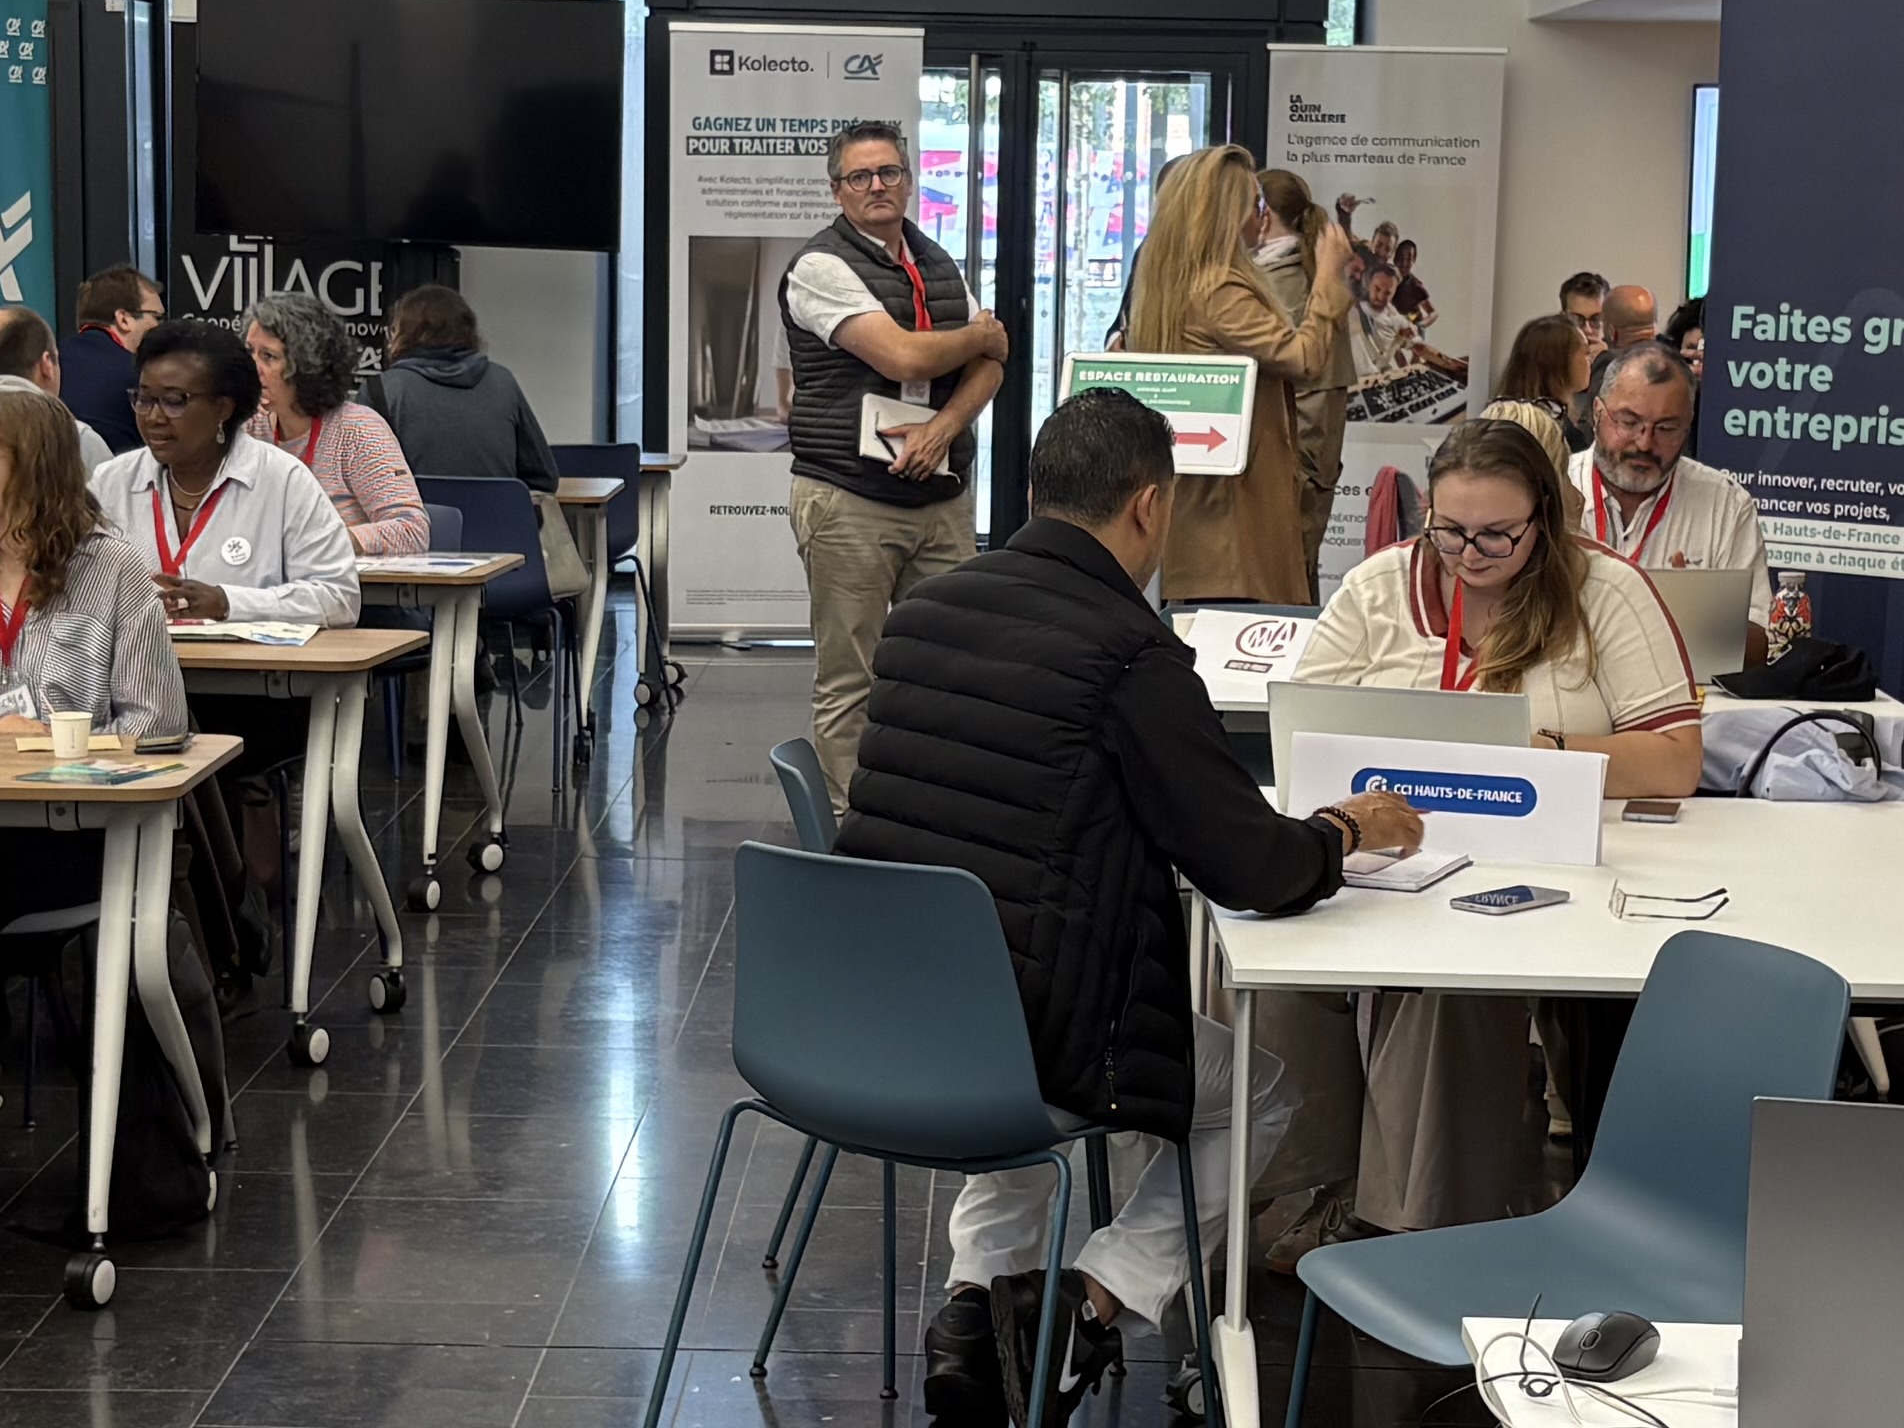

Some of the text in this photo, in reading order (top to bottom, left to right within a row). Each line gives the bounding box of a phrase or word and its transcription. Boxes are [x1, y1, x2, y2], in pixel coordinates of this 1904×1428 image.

[738, 55, 814, 72] Kolecto.
[1289, 94, 1303, 104] LA
[1289, 104, 1322, 113] QUIN
[692, 116, 752, 132] GAGNEZ
[756, 118, 777, 132] UN
[779, 118, 828, 133] TEMPS
[1289, 113, 1347, 123] CAILLERIE
[688, 138, 828, 154] POUR TRAITER VOS
[1287, 133, 1480, 148] L'agence de communication
[1286, 150, 1466, 166] la plus marteau de France
[701, 187, 763, 196] administratives
[741, 199, 780, 208] conforme
[1731, 303, 1852, 345] Faites
[1079, 370, 1240, 385] ESPACE RESTAURATION
[1728, 356, 1834, 393] votre
[1758, 470, 1817, 491] innover,
[1820, 475, 1884, 497] recruter,
[1805, 501, 1830, 515] vos
[1834, 502, 1890, 522] projets,
[1773, 521, 1900, 546] Hauts-de-France
[1815, 548, 1825, 564] à
[1829, 551, 1887, 571] chaque
[1393, 783, 1523, 803] CCI HAUTS-DE-FRANCE
